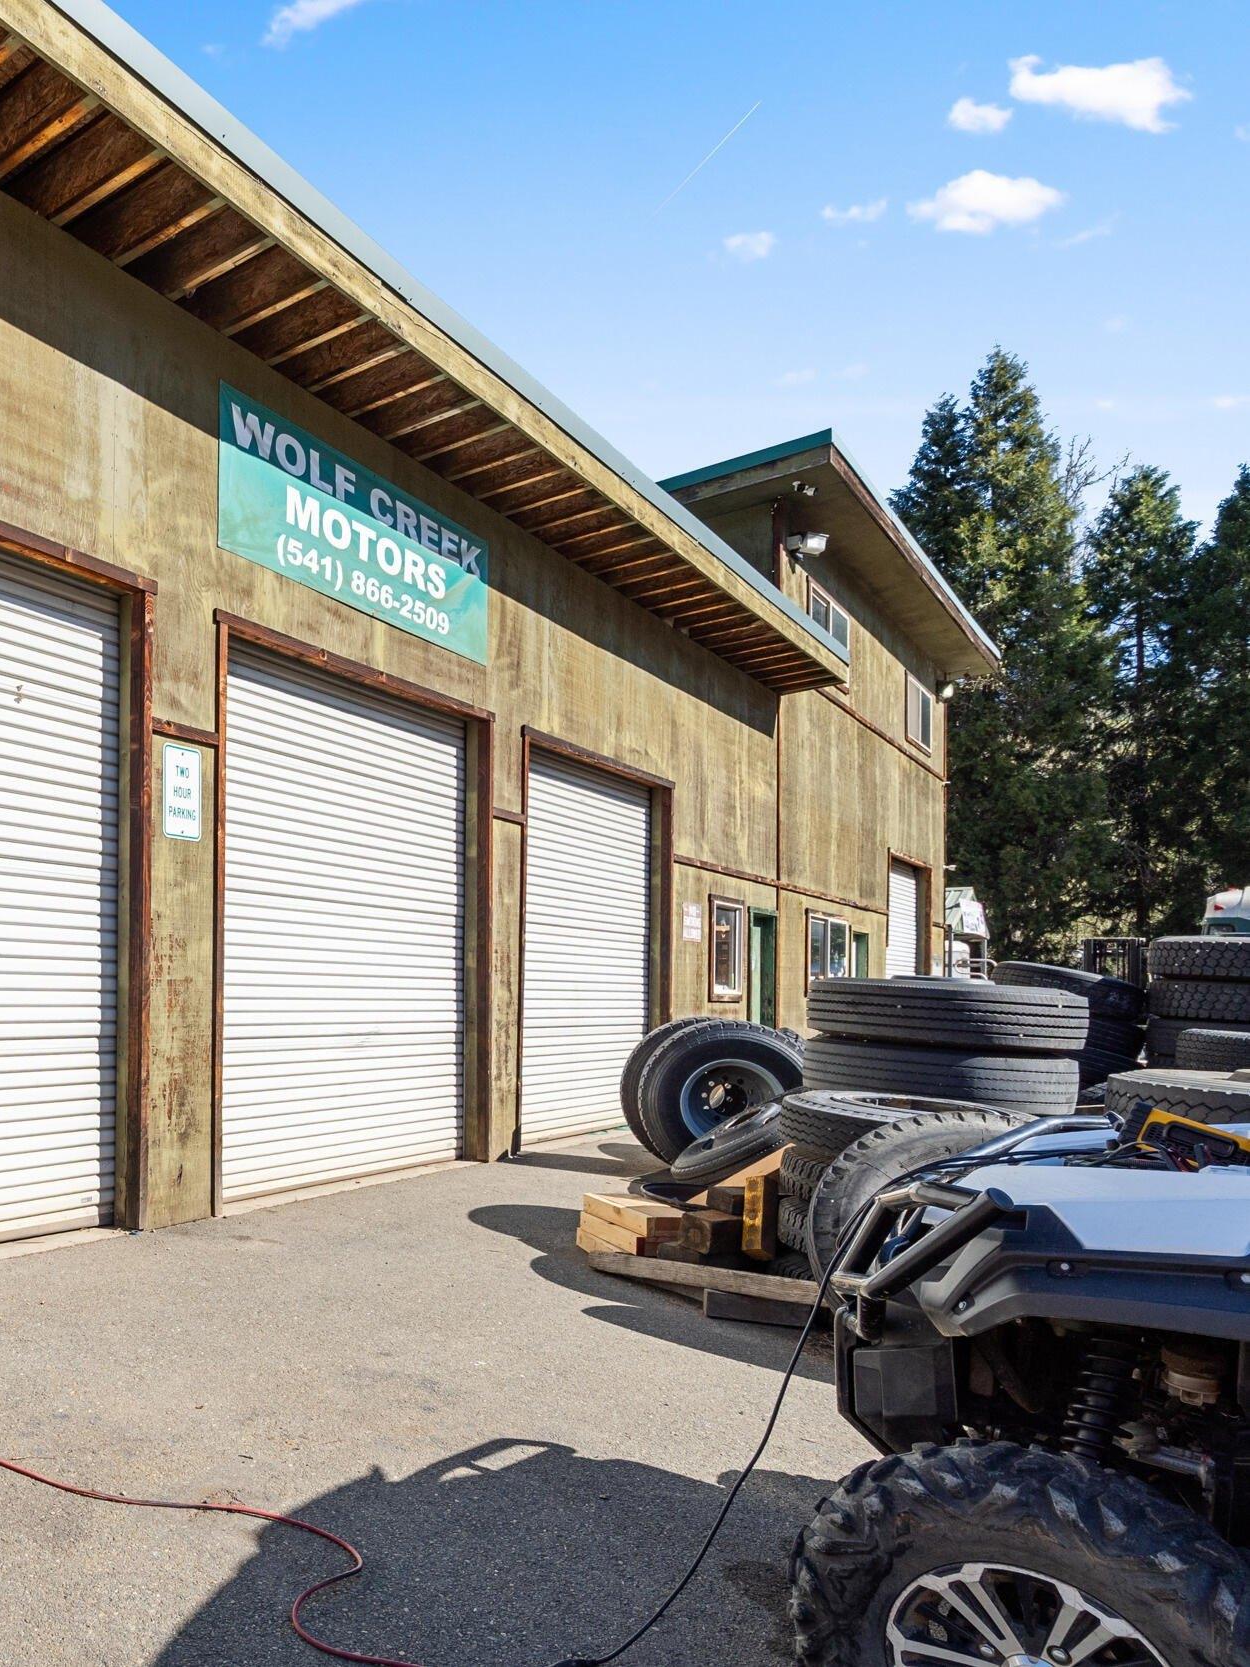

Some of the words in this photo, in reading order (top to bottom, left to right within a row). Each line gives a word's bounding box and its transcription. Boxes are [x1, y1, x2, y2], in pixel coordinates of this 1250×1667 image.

[231, 402, 356, 502] WOLF
[369, 488, 482, 577] CREEK
[285, 484, 447, 600] MOTORS
[276, 534, 344, 591] (541)
[351, 570, 449, 635] 866-2509
[173, 786, 192, 800] HOUR
[175, 765, 190, 779] TWO
[168, 805, 197, 821] PARKING
